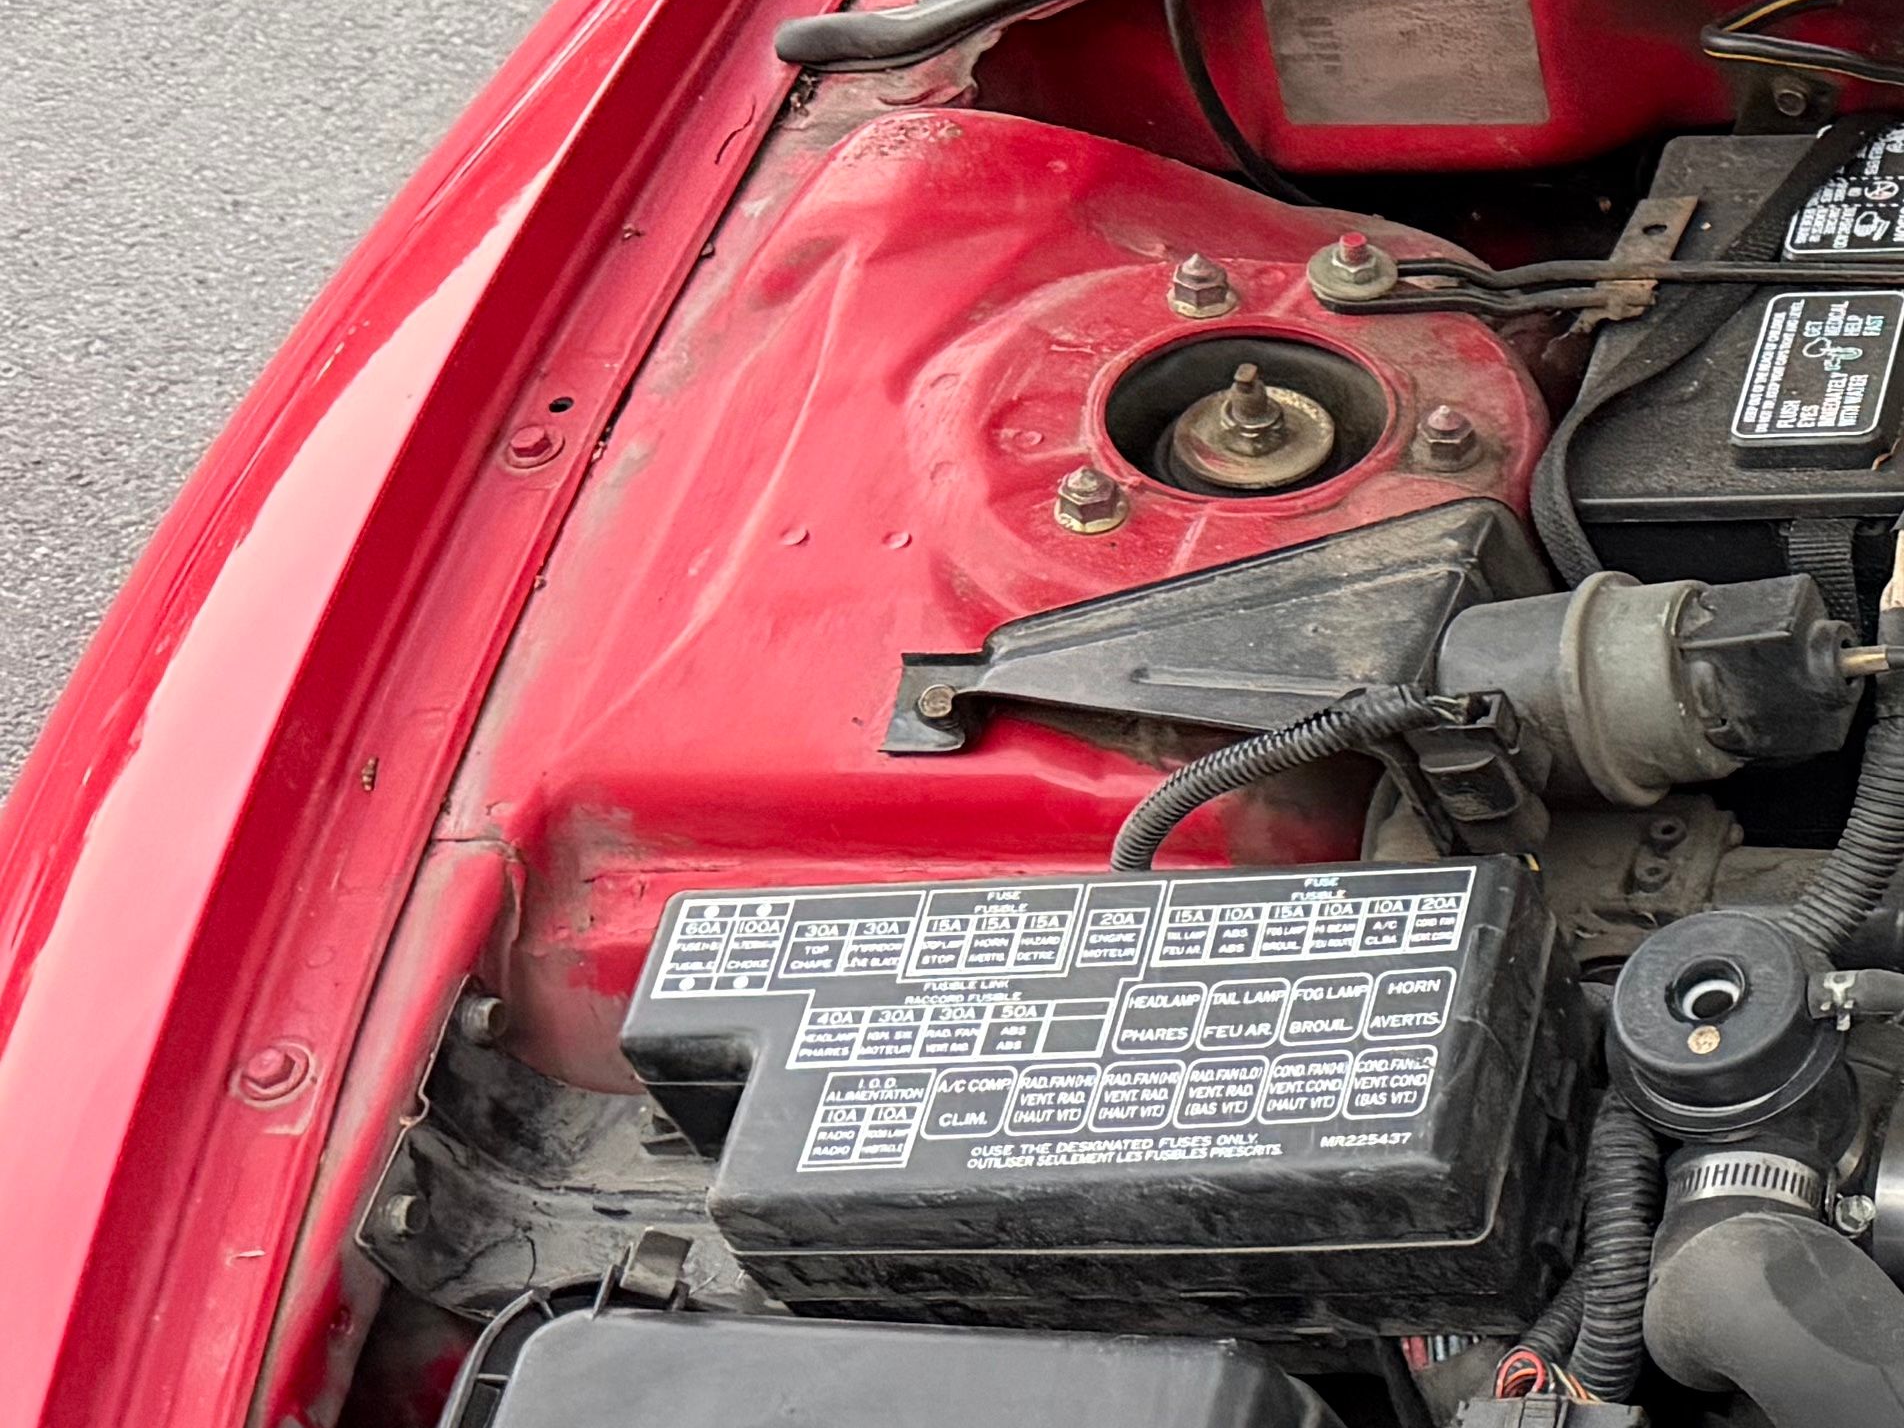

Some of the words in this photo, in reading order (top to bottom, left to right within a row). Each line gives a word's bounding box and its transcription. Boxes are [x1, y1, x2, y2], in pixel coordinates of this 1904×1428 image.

[1823, 300, 1850, 337] MEDICAL
[1843, 314, 1864, 337] HELP
[1862, 315, 1885, 337] FAST
[1803, 321, 1824, 338] GET
[1844, 374, 1869, 405] WATER
[1776, 400, 1802, 429] FLUSH
[1797, 404, 1820, 428] EYES
[1304, 876, 1340, 888] FUSE
[987, 890, 1022, 901] FUSE
[1175, 909, 1206, 923] 15A
[1223, 907, 1255, 921] 10A
[1274, 905, 1306, 919] 15A
[1322, 903, 1355, 917] 10A
[1373, 900, 1405, 914] 10A
[1421, 897, 1458, 911] 20A
[686, 922, 721, 936] 60A
[738, 919, 780, 934] 100A
[932, 920, 962, 933] 15A
[981, 917, 1012, 931] 15A
[1030, 915, 1061, 928] 15A
[1099, 913, 1135, 926] 20A
[1372, 920, 1398, 931] A/C
[804, 923, 840, 938] 30A
[863, 921, 900, 936] 30A
[1222, 928, 1249, 940] ABS
[1089, 933, 1137, 944] ENGINE
[1082, 947, 1136, 959] MOTEUR
[1218, 943, 1246, 955] ABS
[980, 978, 1010, 989] LINK
[1387, 979, 1441, 995] HORN
[904, 993, 964, 1005] RACCORD
[1210, 991, 1240, 1006] TAIL
[1245, 989, 1286, 1005] LAMP
[1293, 987, 1324, 1002] FOG
[1326, 984, 1369, 1001] LAMP
[1128, 993, 1200, 1010] HEADLAMP
[816, 1010, 854, 1026] 40A
[878, 1008, 915, 1024] 30A
[938, 1006, 977, 1022] 30A
[1001, 1004, 1038, 1019] 50A
[1370, 1011, 1442, 1029] AVERTIS.
[1001, 1025, 1027, 1037] ABS
[1120, 1027, 1189, 1042] PHARES
[1203, 1024, 1244, 1039] FEU
[1245, 1022, 1273, 1038] AR.
[995, 1040, 1023, 1051] ABS
[937, 1078, 966, 1094] A/C
[824, 1087, 925, 1103] ALIMENTATION
[1354, 1091, 1387, 1107] (BAS
[1098, 1104, 1138, 1120] (HAUT
[1184, 1101, 1217, 1117] (BAS
[1266, 1096, 1307, 1113] (HAUT
[827, 1108, 858, 1122] 10A
[877, 1107, 909, 1121] 10A
[938, 1112, 989, 1128] CLIM.
[1013, 1109, 1054, 1124] (HAUT
[817, 1129, 856, 1141] RADIO
[1320, 1132, 1413, 1149] MR225437
[812, 1145, 852, 1156] RADIO
[1019, 1142, 1053, 1155] THE
[1056, 1137, 1154, 1154] DESIGNATED
[1158, 1134, 1213, 1149] FUSES
[1036, 1151, 1116, 1167] SEULEMENT
[1116, 1149, 1144, 1164] LES
[1144, 1146, 1208, 1163] FUSIBLES
[1208, 1142, 1284, 1160] PRESCRITS.
